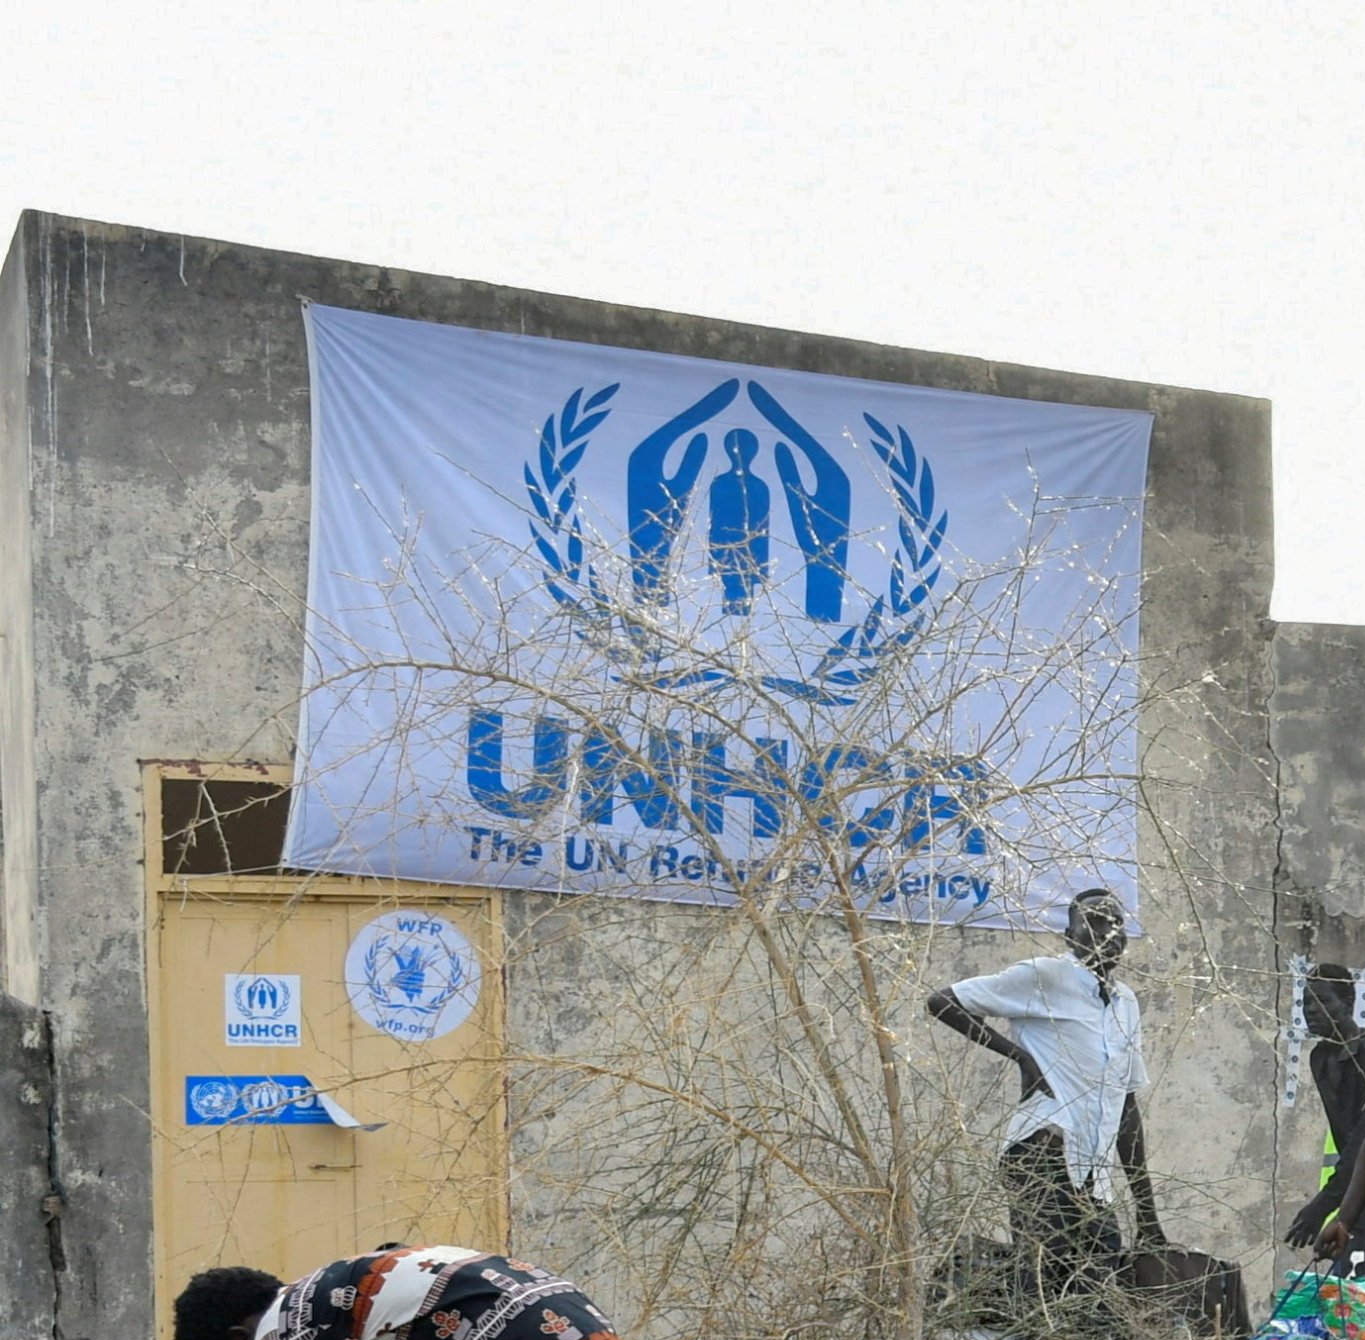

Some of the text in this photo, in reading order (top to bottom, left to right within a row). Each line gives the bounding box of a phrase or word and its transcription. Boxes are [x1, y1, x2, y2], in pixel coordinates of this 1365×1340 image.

[466, 708, 988, 854] UNHCR
[464, 827, 543, 866] The
[565, 836, 628, 875] UN
[397, 917, 444, 937] WFP
[227, 1023, 298, 1037] UNHCR
